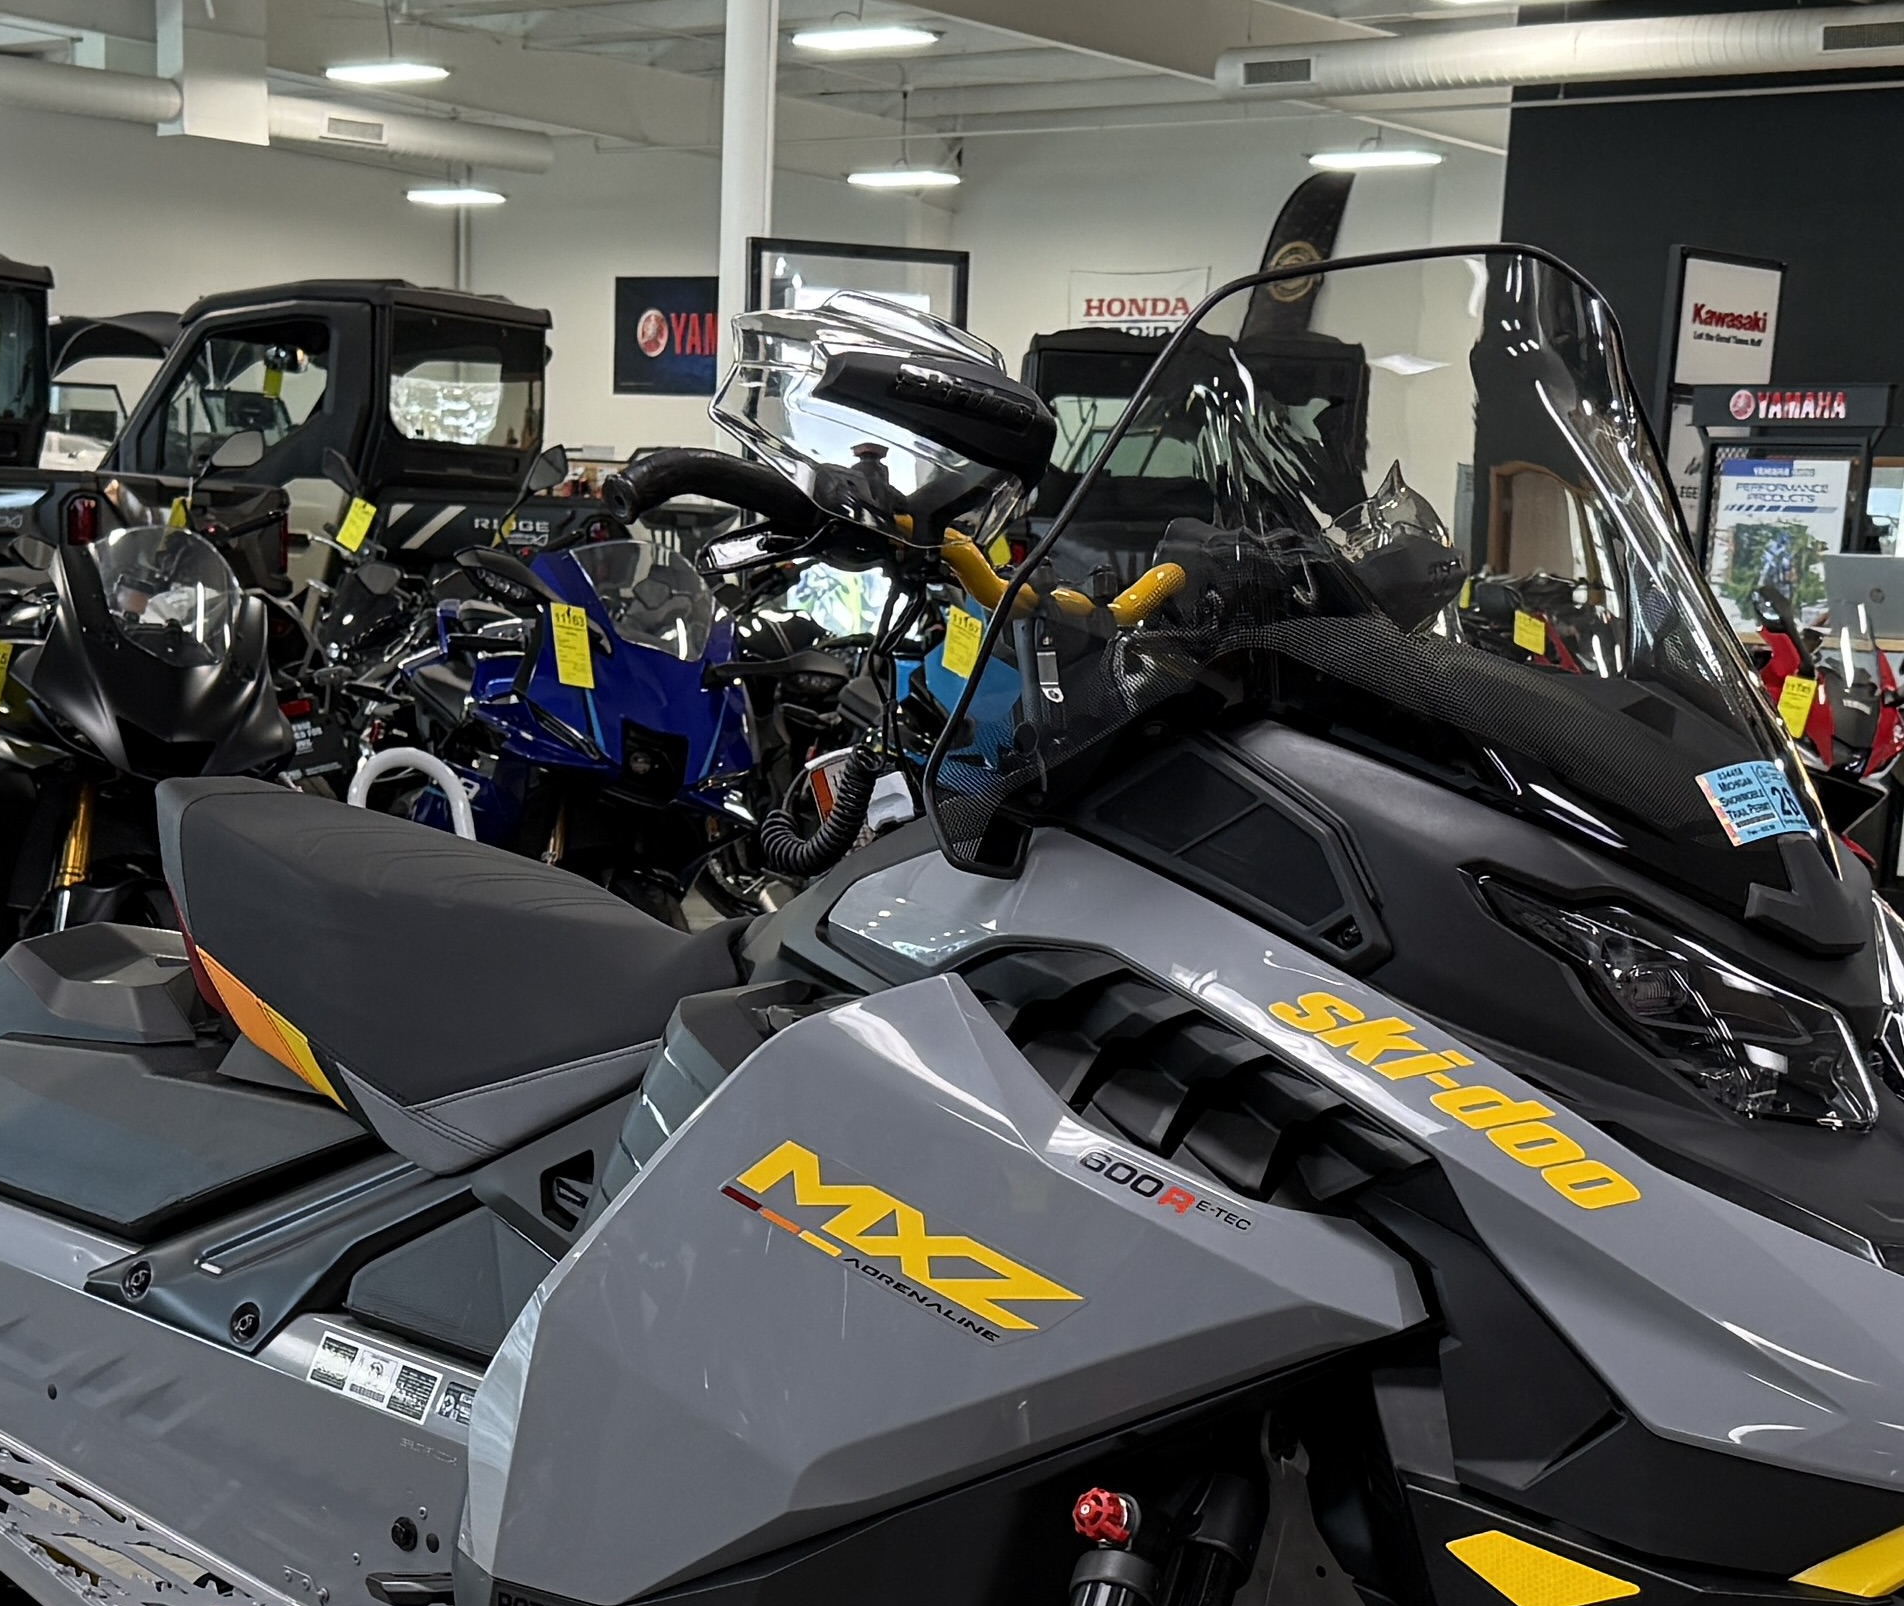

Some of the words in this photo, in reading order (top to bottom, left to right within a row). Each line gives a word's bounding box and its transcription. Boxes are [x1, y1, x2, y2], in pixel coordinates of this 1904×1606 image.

[1083, 297, 1191, 317] HONDA
[1692, 303, 1768, 333] Kawasaki
[670, 312, 717, 355] YAM
[1757, 392, 1846, 419] YAMAHA
[1736, 482, 1828, 494] PERFORMANCE
[1747, 494, 1815, 504] PRODUCTS
[1770, 786, 1800, 817] 26
[1268, 991, 1641, 1210] ski-doo
[1196, 1200, 1252, 1231] E-TEC
[736, 1140, 1086, 1330] MXZ
[843, 1257, 1001, 1343] ADRENALINE
